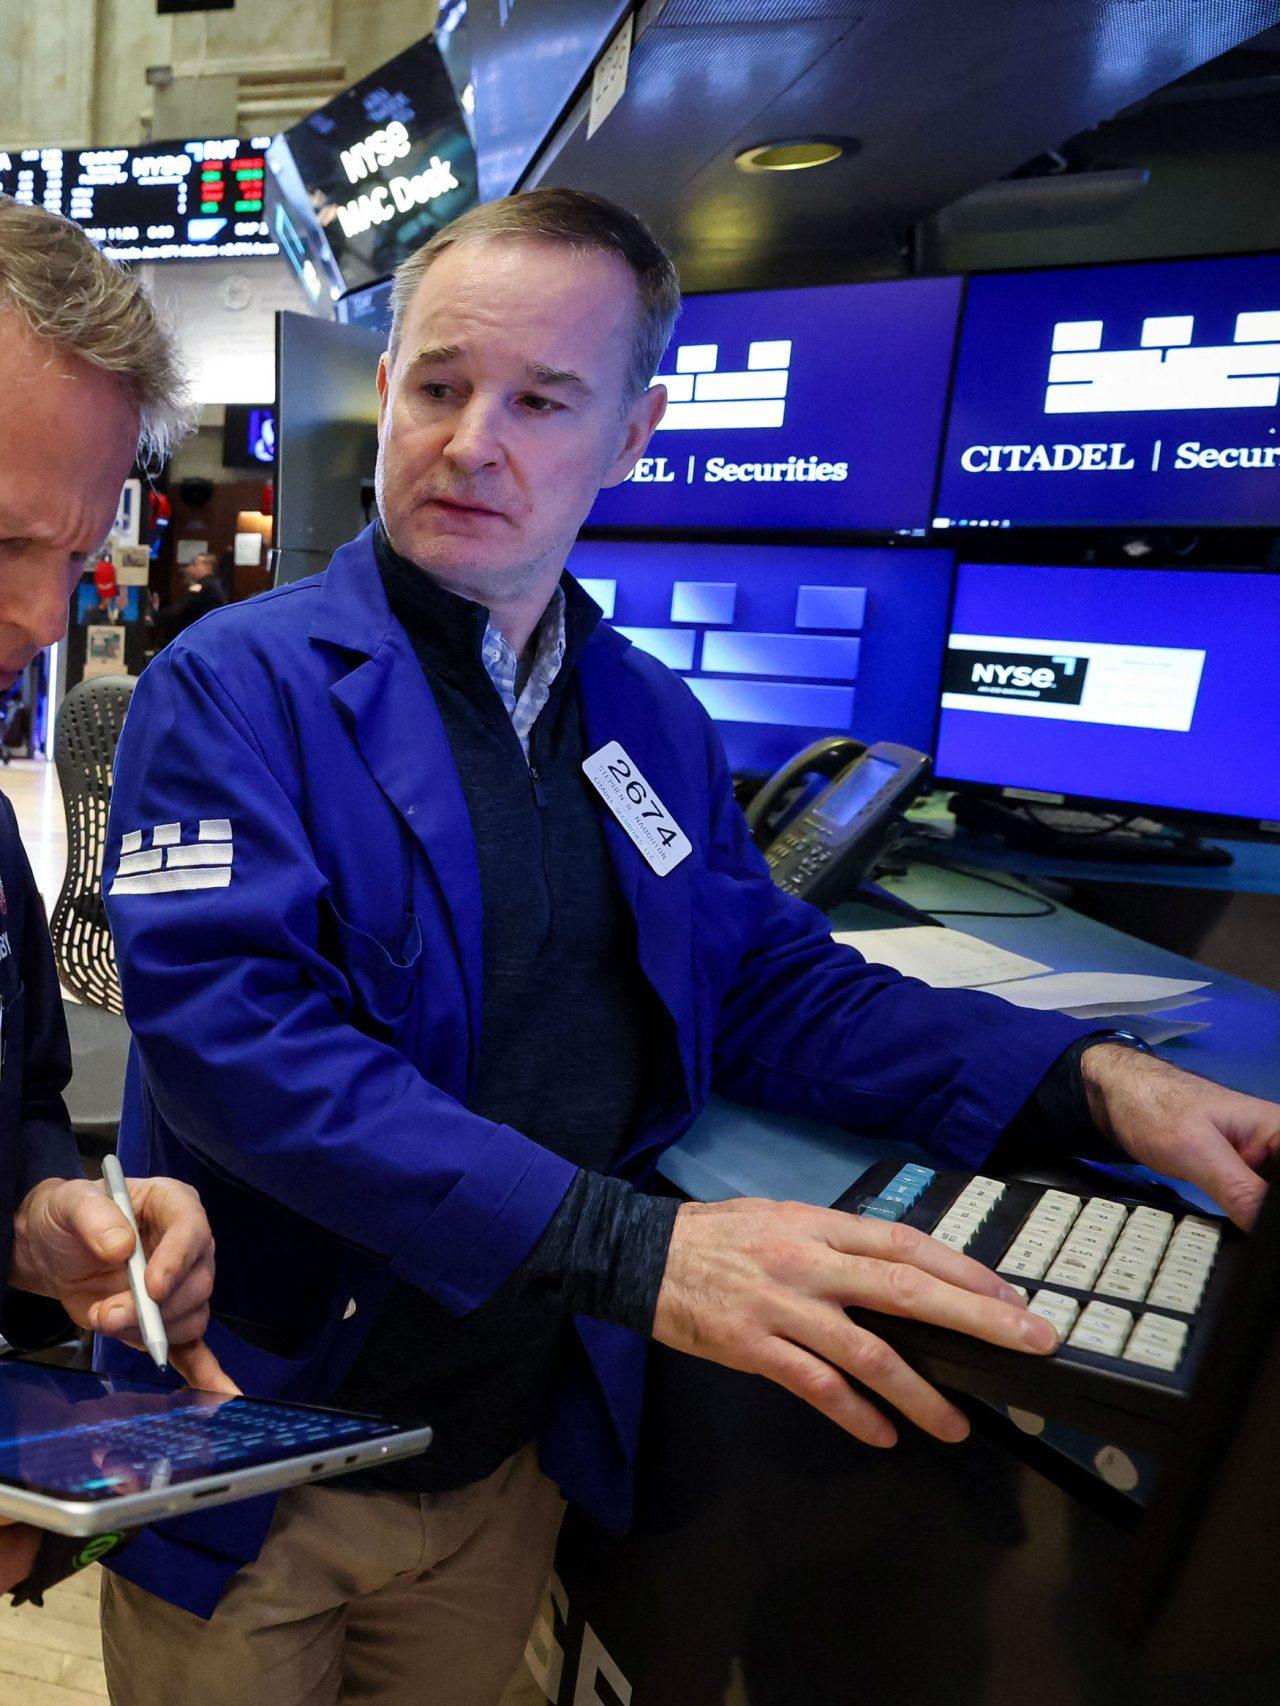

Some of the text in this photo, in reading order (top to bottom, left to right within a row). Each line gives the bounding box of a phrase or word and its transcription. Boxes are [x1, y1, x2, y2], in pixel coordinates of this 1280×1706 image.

[704, 455, 849, 482] Securities
[960, 442, 1135, 473] CITADEL
[608, 759, 677, 847] 2674
